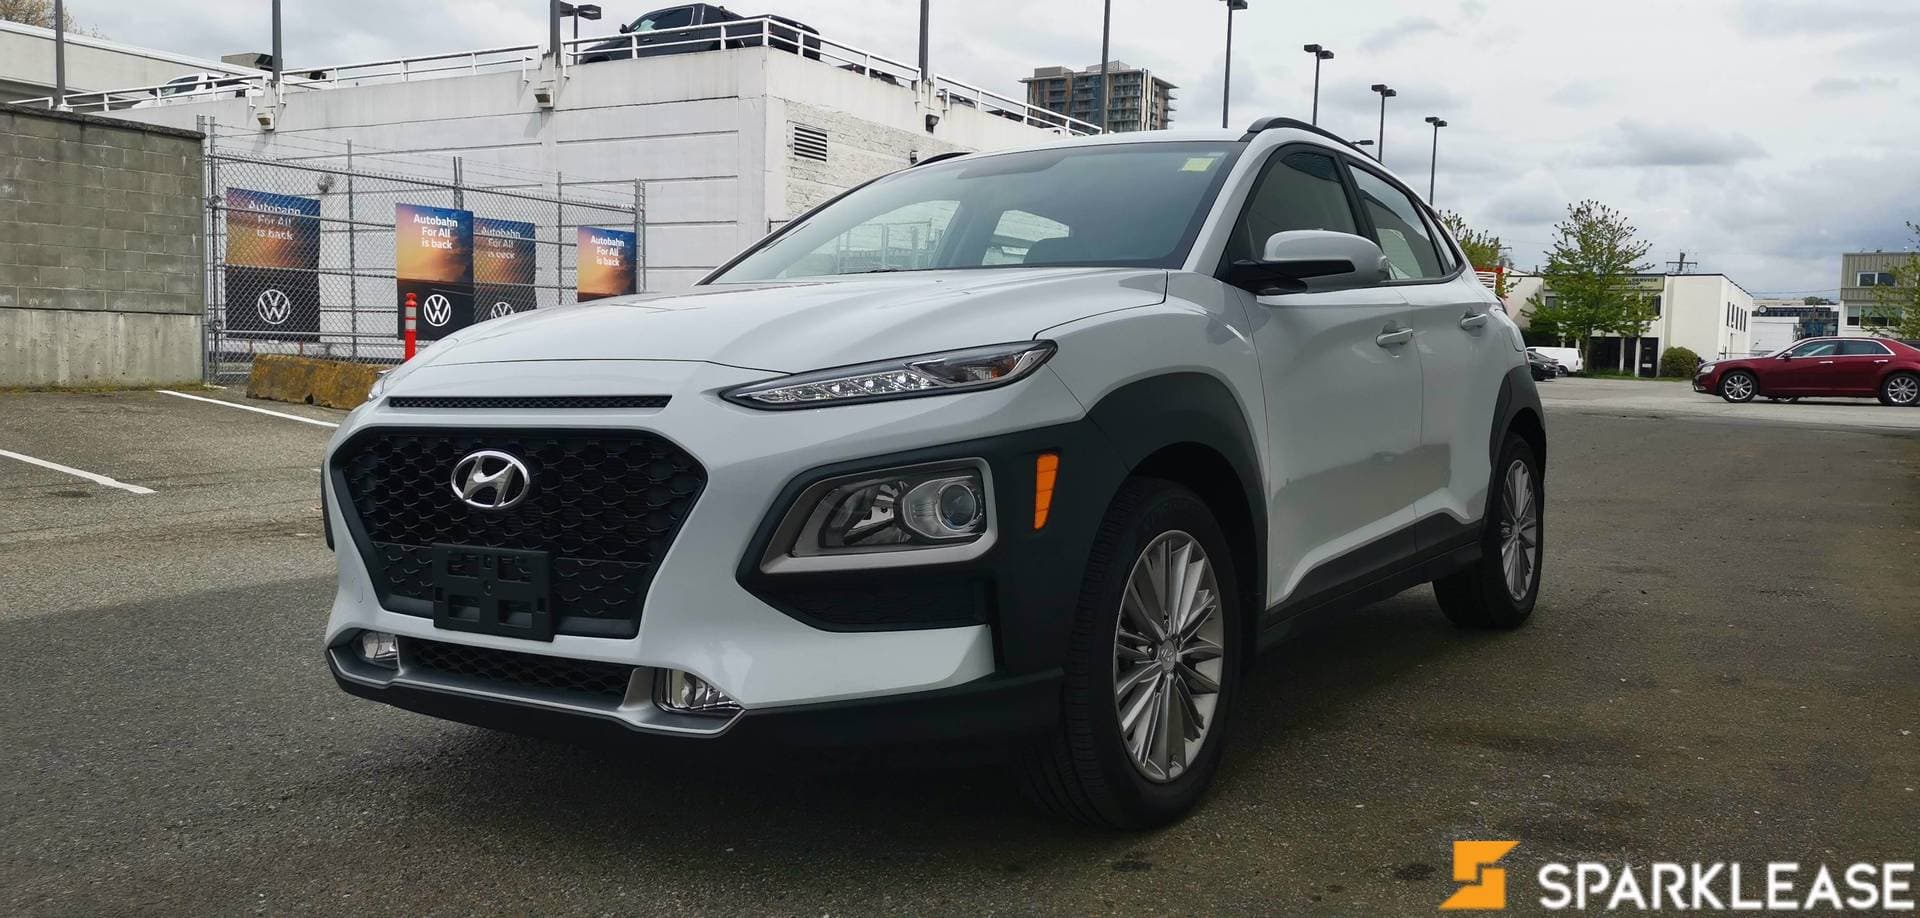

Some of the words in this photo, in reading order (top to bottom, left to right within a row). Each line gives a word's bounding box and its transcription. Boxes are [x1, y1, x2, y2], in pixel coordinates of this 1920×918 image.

[249, 200, 301, 216] Autobahn
[258, 214, 275, 225] For
[413, 213, 458, 228] Autobahn
[422, 226, 437, 237] For
[438, 227, 451, 238] All
[421, 237, 430, 248] is
[431, 238, 453, 250] back
[590, 235, 625, 247] Autobahn
[596, 246, 609, 256] For
[609, 247, 619, 257] All
[603, 256, 620, 267] back
